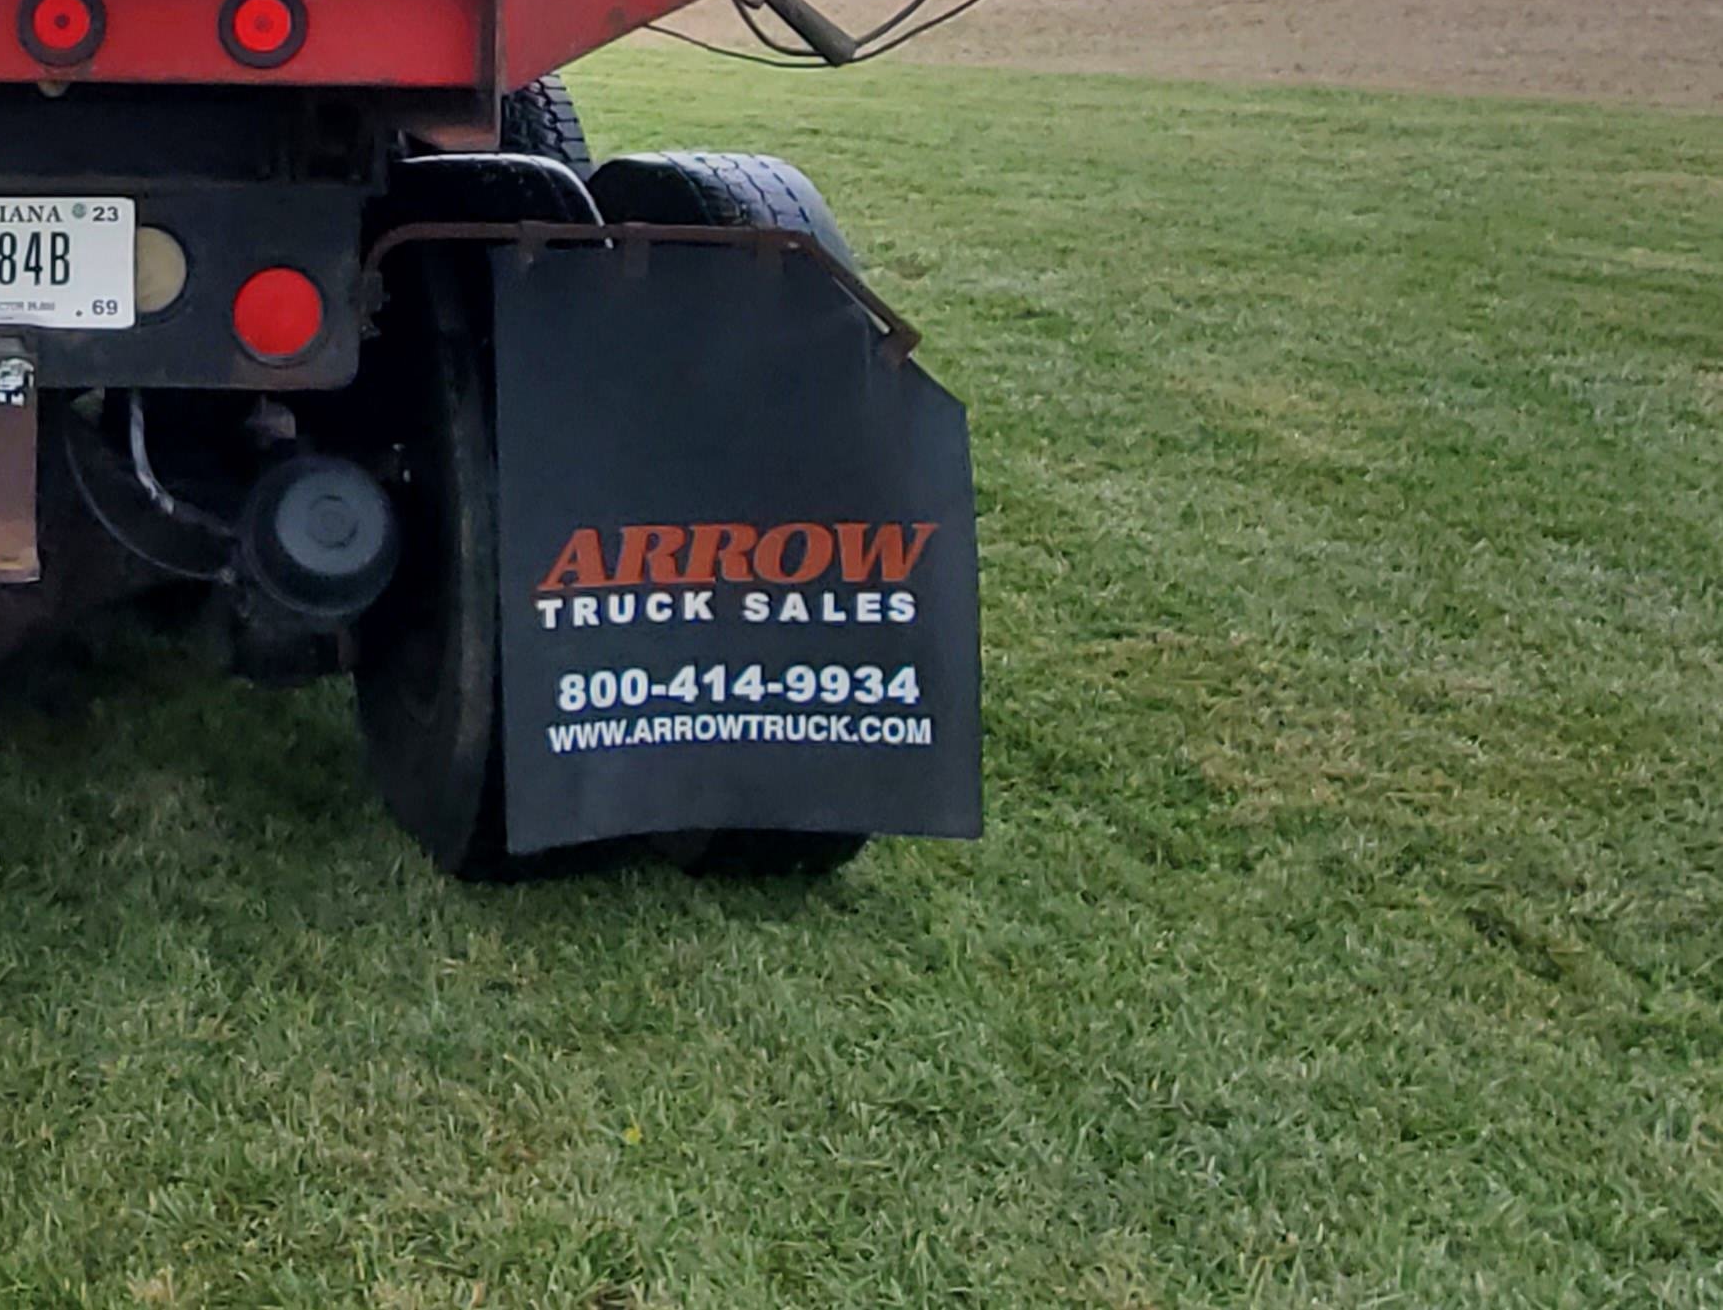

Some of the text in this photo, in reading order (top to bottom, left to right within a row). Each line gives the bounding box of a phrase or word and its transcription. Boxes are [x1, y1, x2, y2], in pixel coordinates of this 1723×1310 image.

[92, 206, 119, 222] 23
[91, 298, 119, 316] 69
[536, 521, 939, 591] ARROW
[536, 590, 917, 629] TRUCK SALES
[558, 664, 920, 712] 800-414-9934
[548, 715, 932, 753] WWW.ARROWTRUCK.COM
